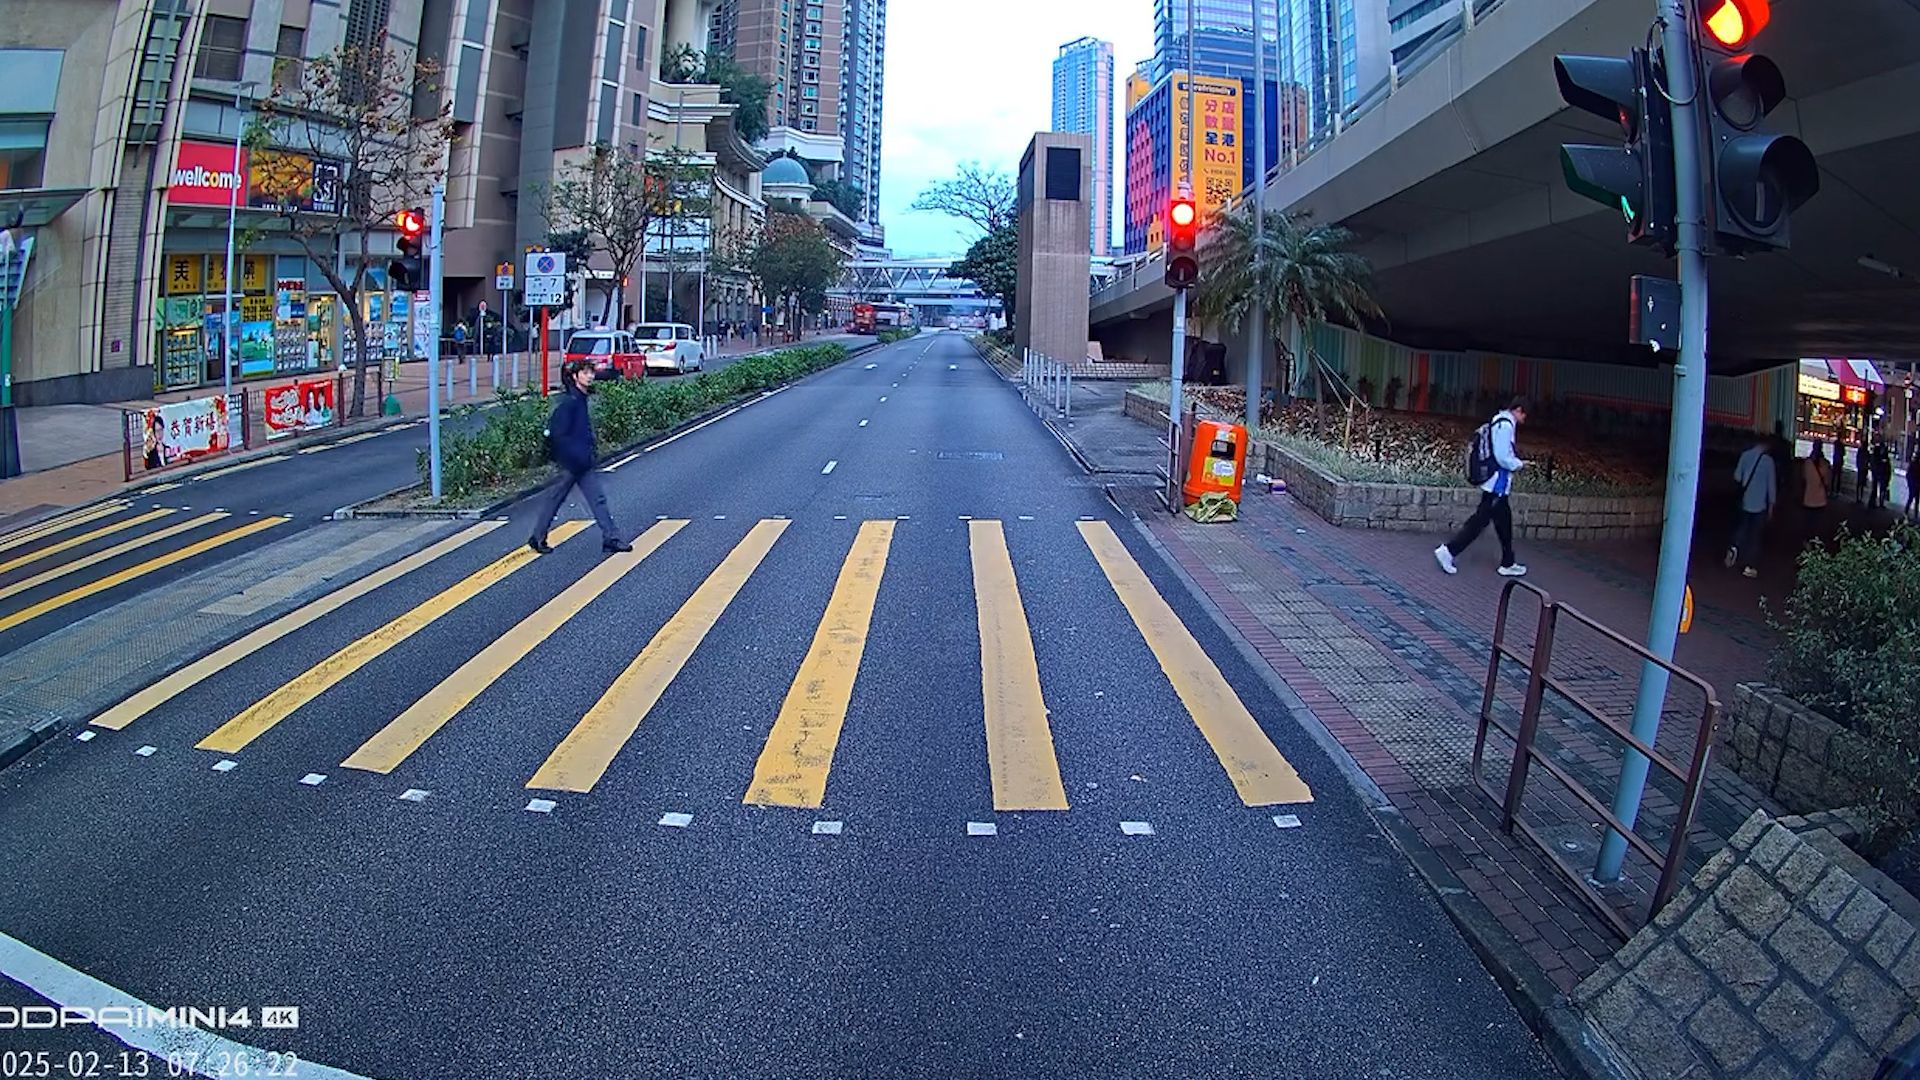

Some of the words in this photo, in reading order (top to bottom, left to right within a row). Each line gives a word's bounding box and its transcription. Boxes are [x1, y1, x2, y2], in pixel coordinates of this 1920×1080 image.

[1205, 99, 1236, 114] 分店
[1205, 131, 1236, 147] 全港
[1205, 149, 1235, 164] No.1
[174, 166, 242, 189] wellcome
[175, 261, 189, 282] 美
[551, 278, 557, 287] 7
[551, 294, 562, 303] 12
[170, 411, 216, 440] 恭賀新禧
